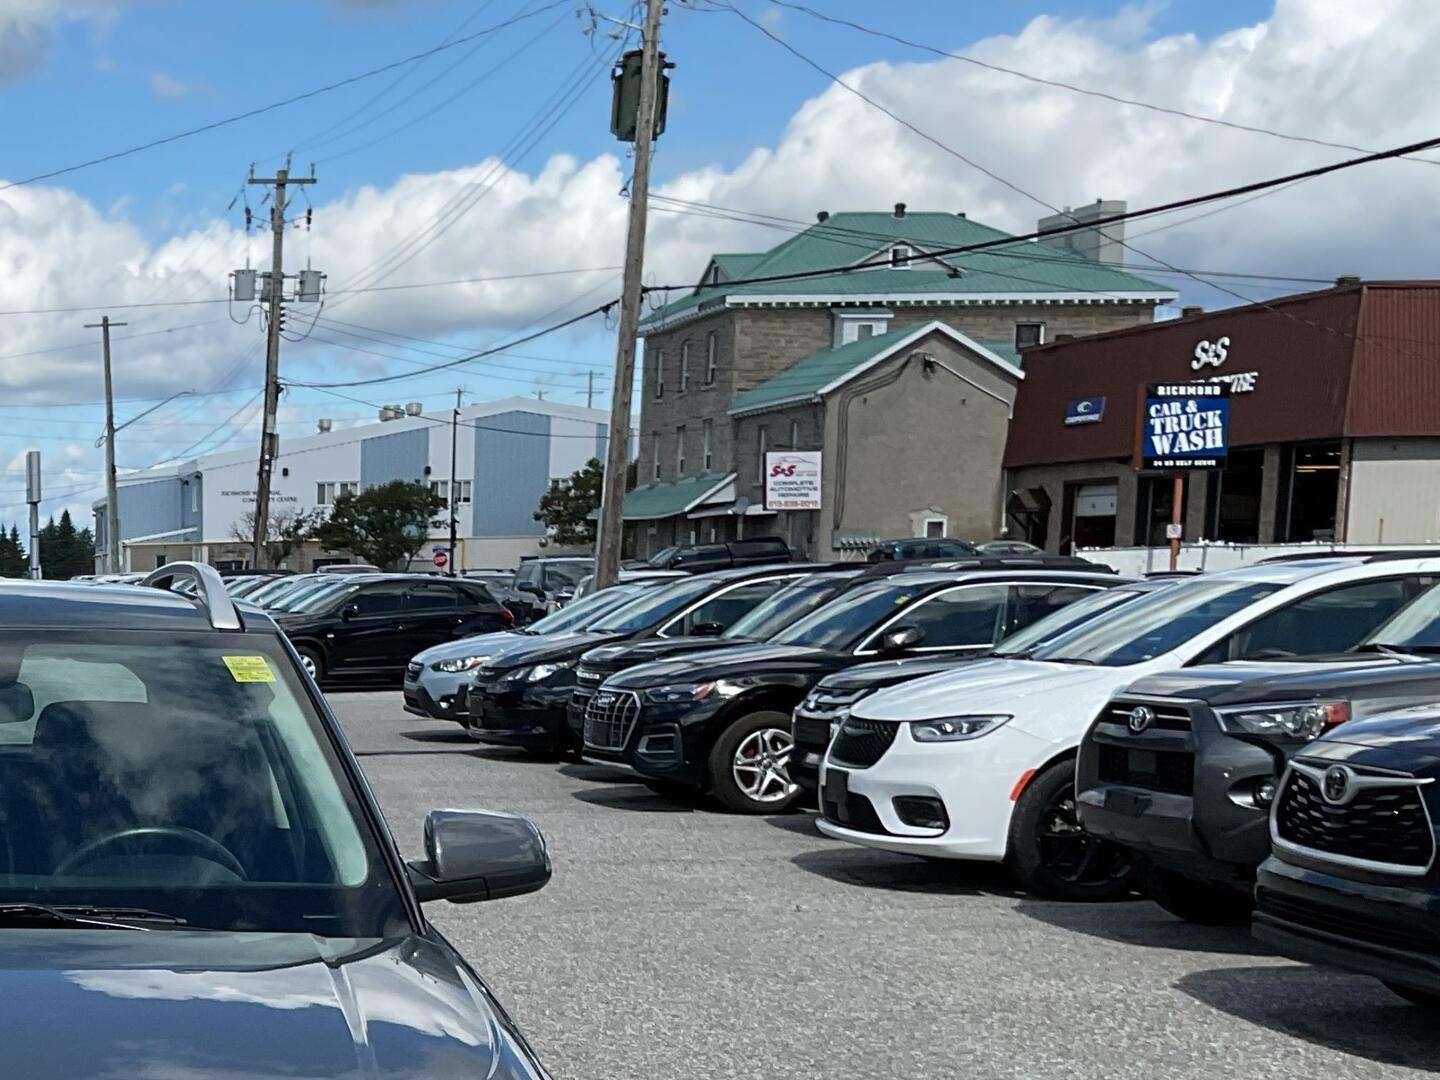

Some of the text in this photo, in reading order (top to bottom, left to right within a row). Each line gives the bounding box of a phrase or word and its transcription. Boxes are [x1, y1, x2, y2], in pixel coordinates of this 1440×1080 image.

[1157, 385, 1221, 396] RICHMOND
[1149, 399, 1198, 418] CAR &
[1150, 409, 1223, 435] TRUCK
[1150, 427, 1224, 456] WASH
